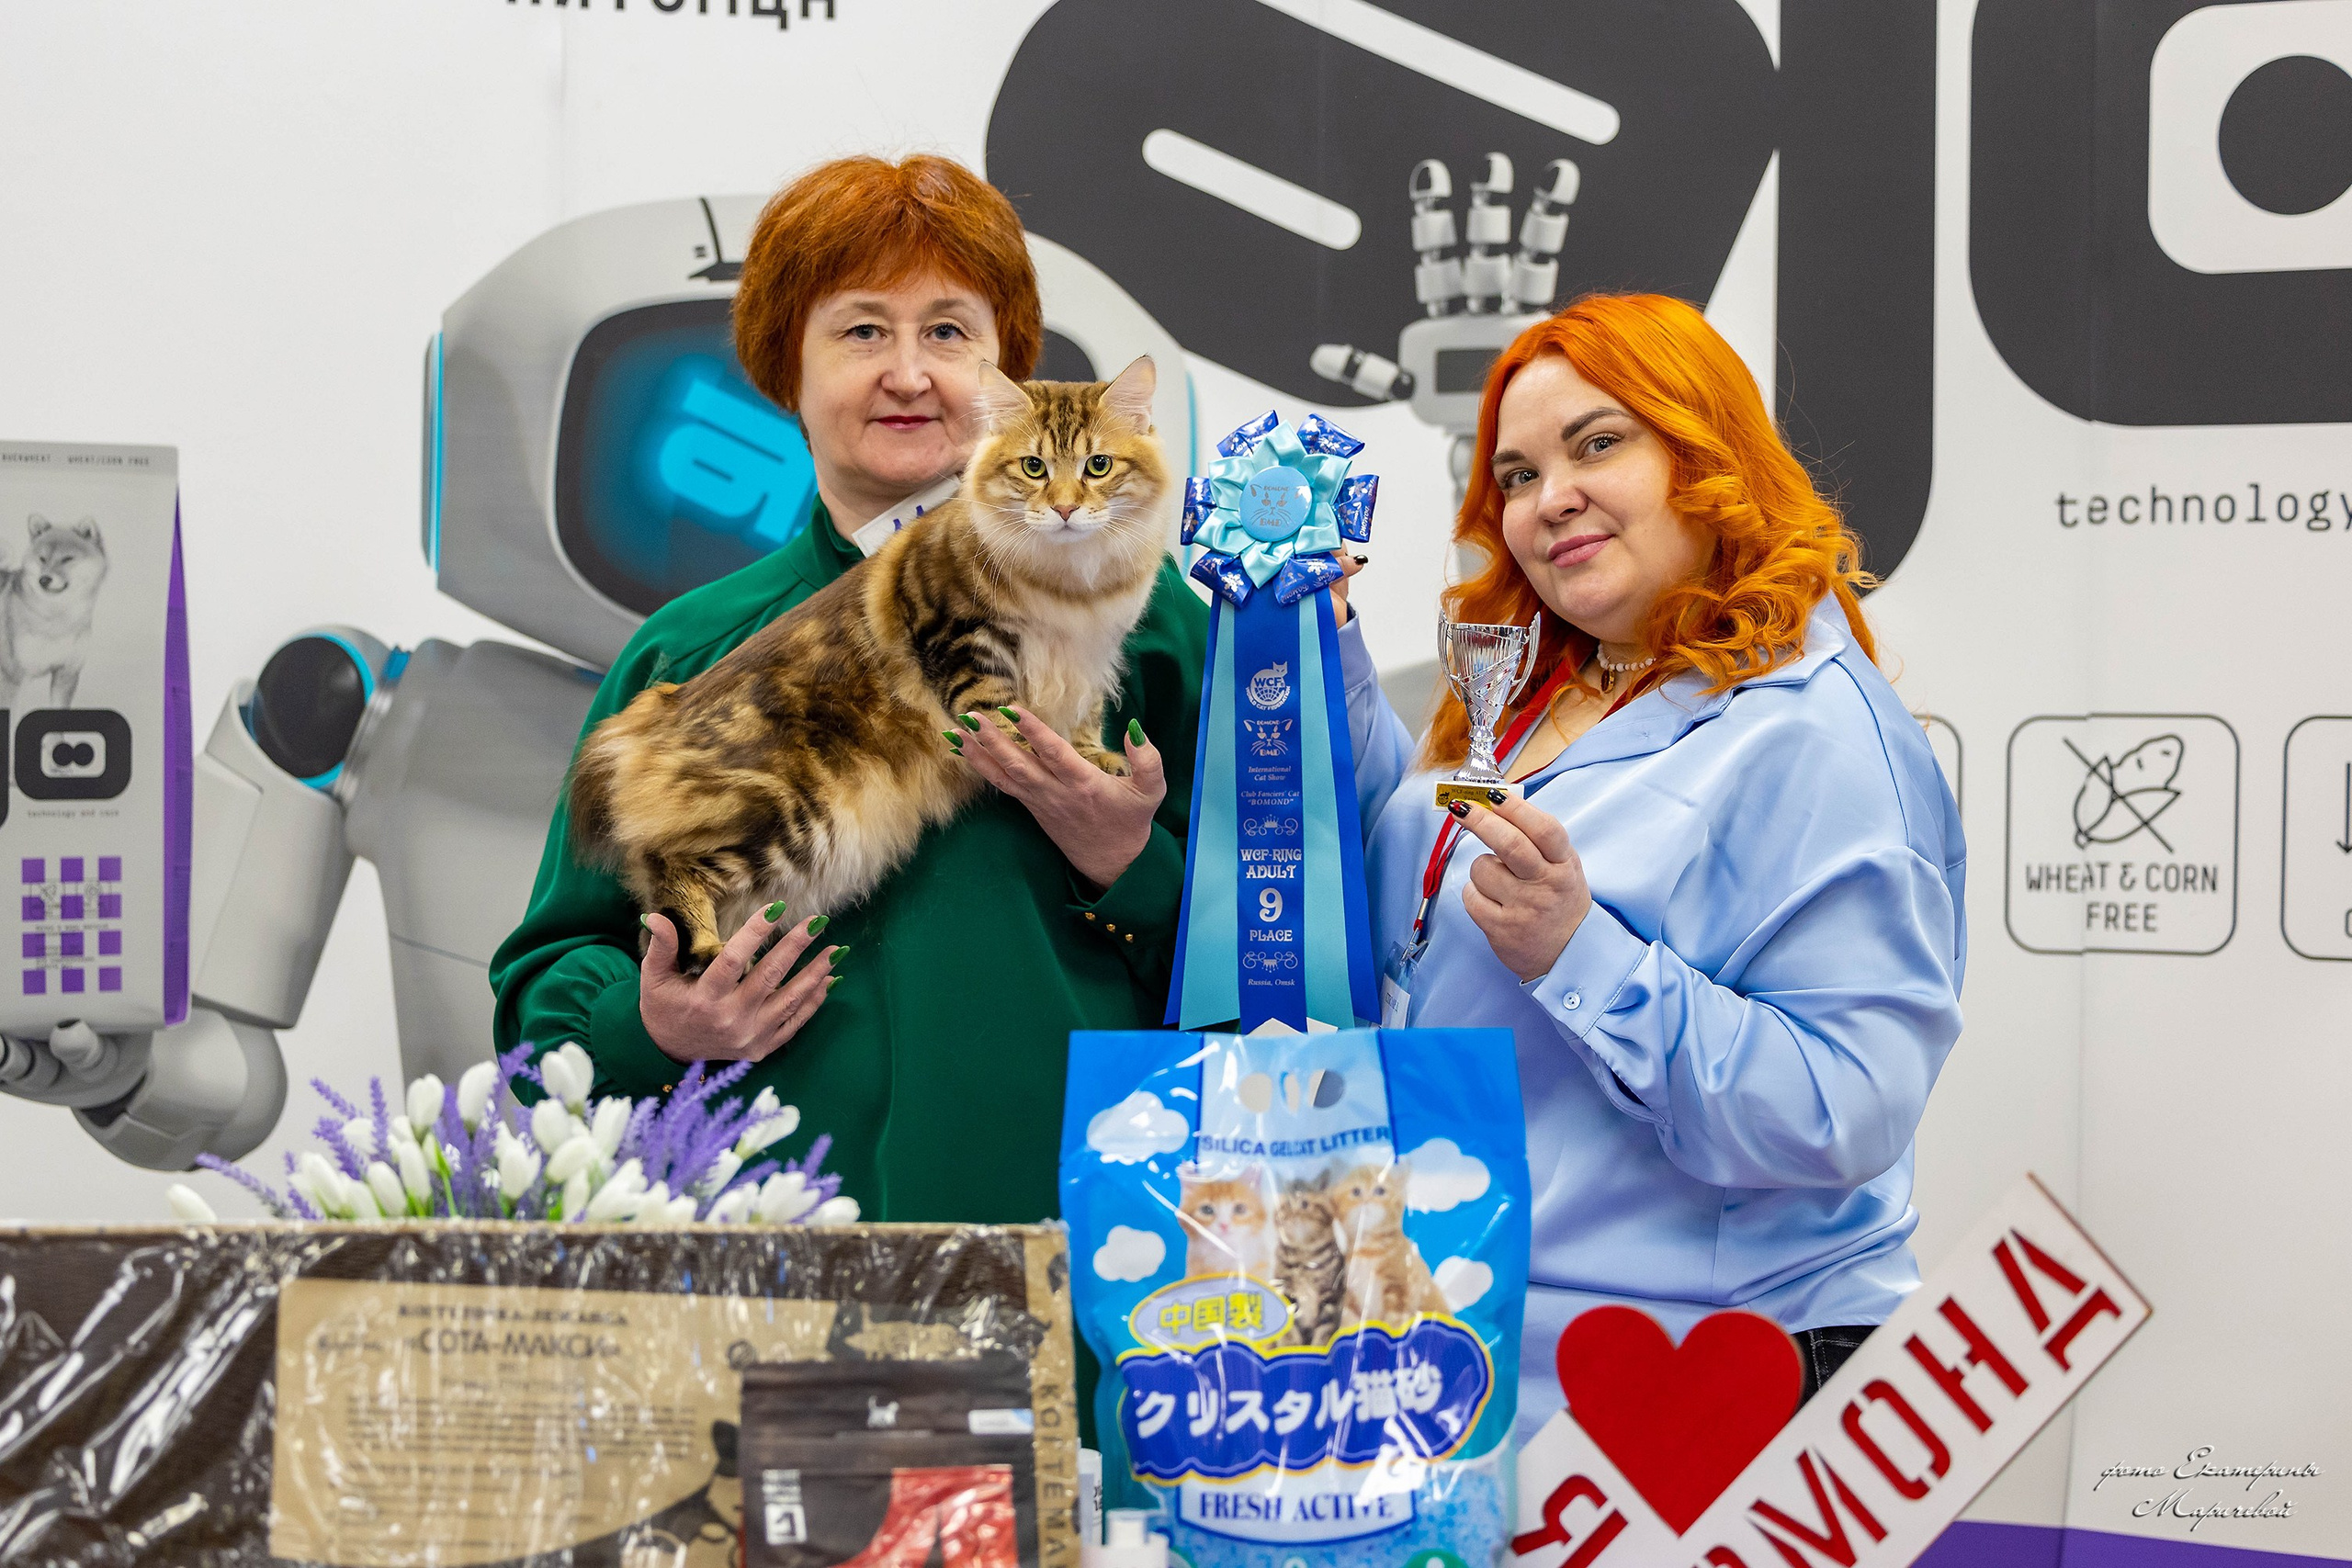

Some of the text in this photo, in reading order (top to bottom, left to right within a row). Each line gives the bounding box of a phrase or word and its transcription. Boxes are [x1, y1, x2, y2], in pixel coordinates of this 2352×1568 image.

[1254, 677, 1282, 688] WCF
[1240, 849, 1302, 863] WCF-RING
[1246, 864, 1296, 879] ADULT
[2025, 863, 2218, 894] WHEAT & CORN
[1259, 887, 1283, 922] 9
[2086, 902, 2159, 932] FREE
[1249, 930, 1293, 942] PLACE
[1248, 978, 1272, 987] Russia,
[1201, 1134, 1266, 1156] SILICA
[1159, 1292, 1264, 1336] 中国製
[1136, 1361, 1443, 1439] クリスタル猫砂
[1690, 1229, 2123, 1568] МОНД
[1199, 1491, 1395, 1522] FRESH ACTIVE
